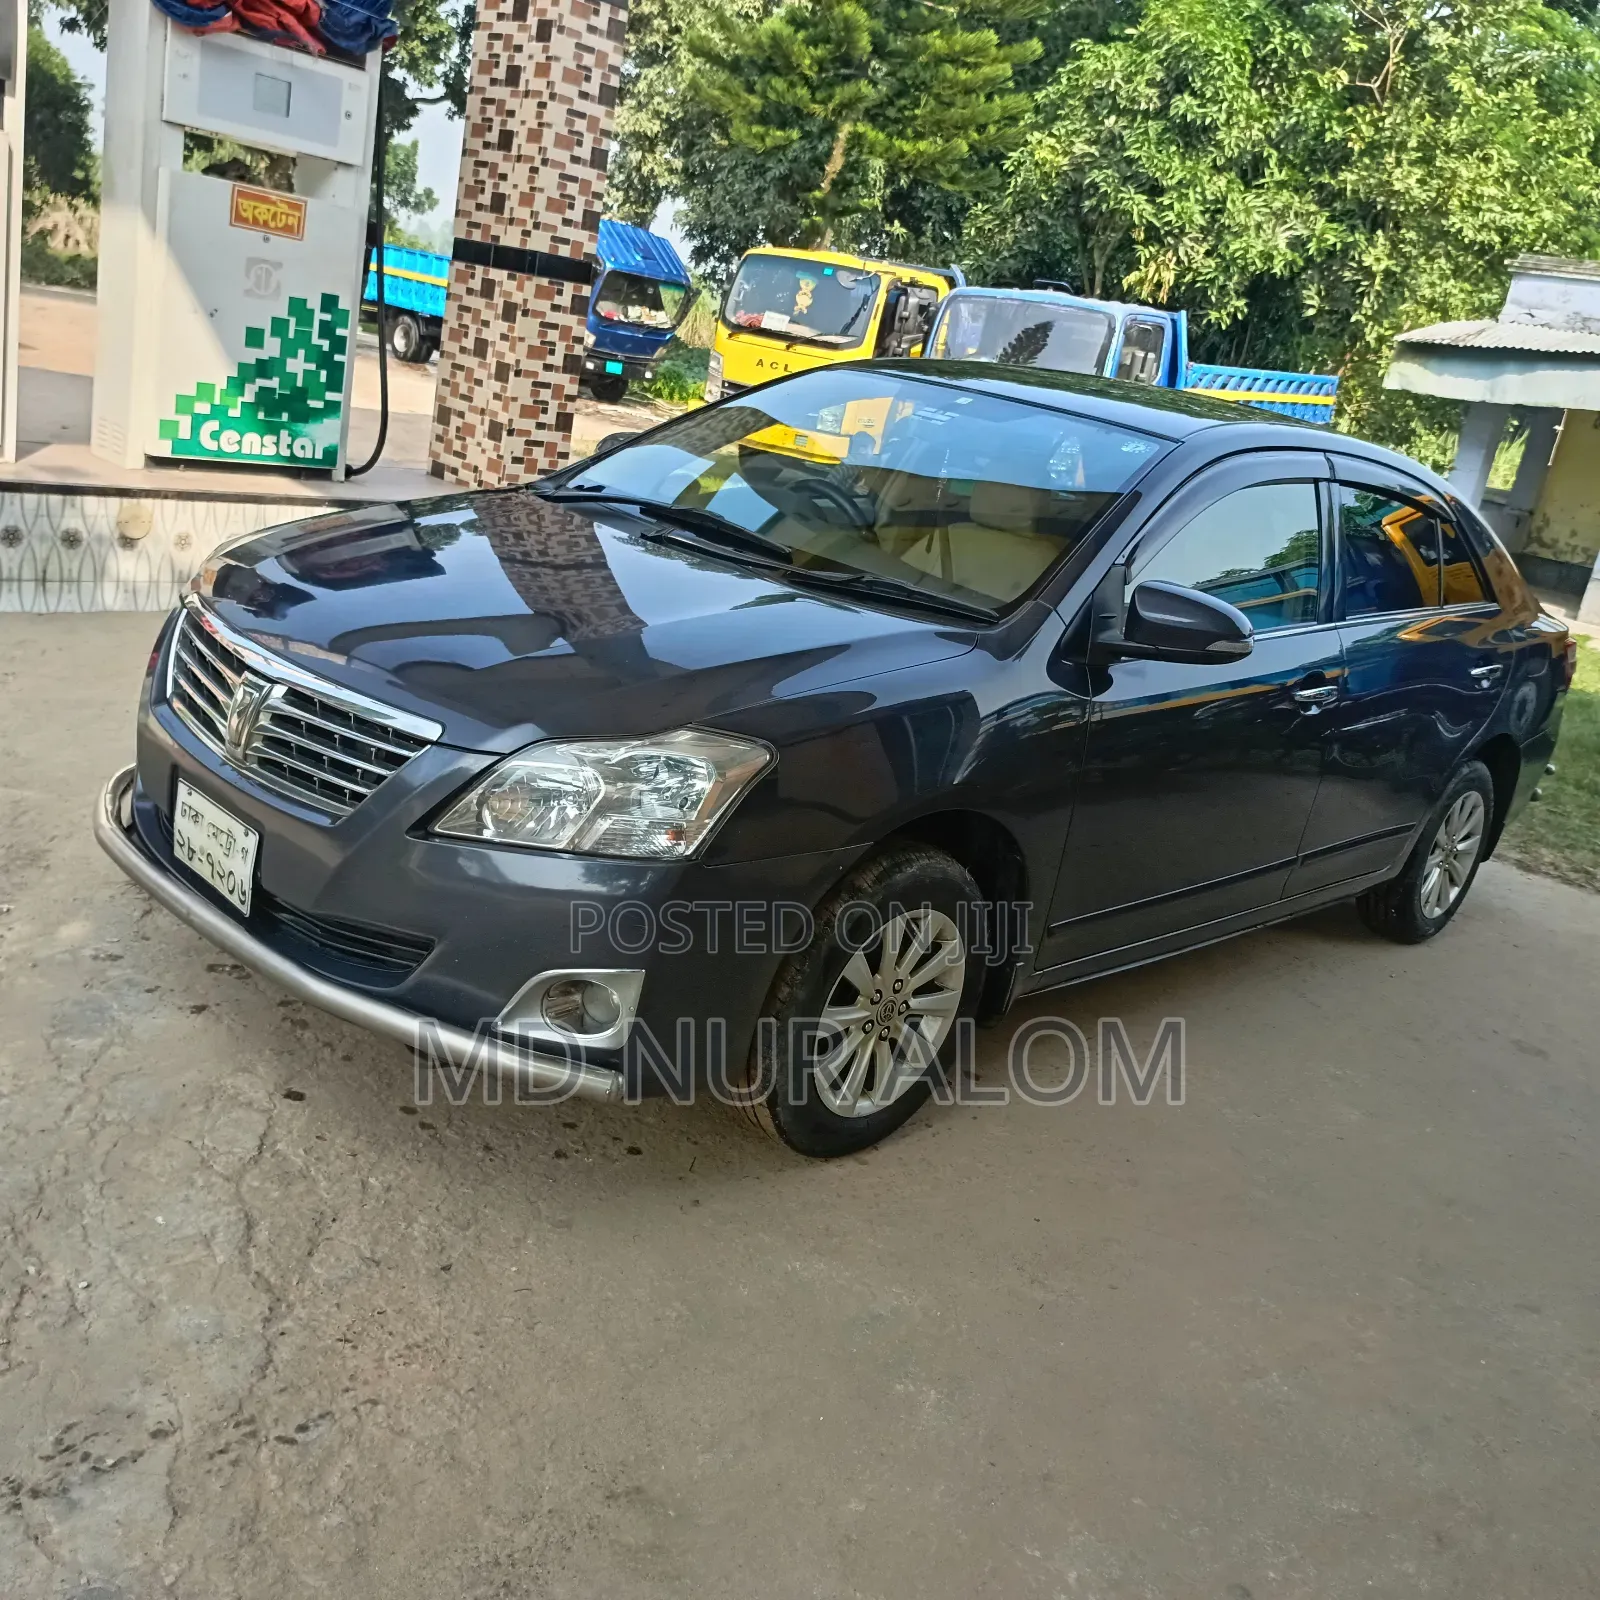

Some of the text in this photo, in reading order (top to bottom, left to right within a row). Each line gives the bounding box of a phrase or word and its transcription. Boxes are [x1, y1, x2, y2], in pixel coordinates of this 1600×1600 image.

[238, 196, 301, 236] অকটেন
[199, 420, 324, 460] Censtar
[180, 801, 204, 826] ঢাকা
